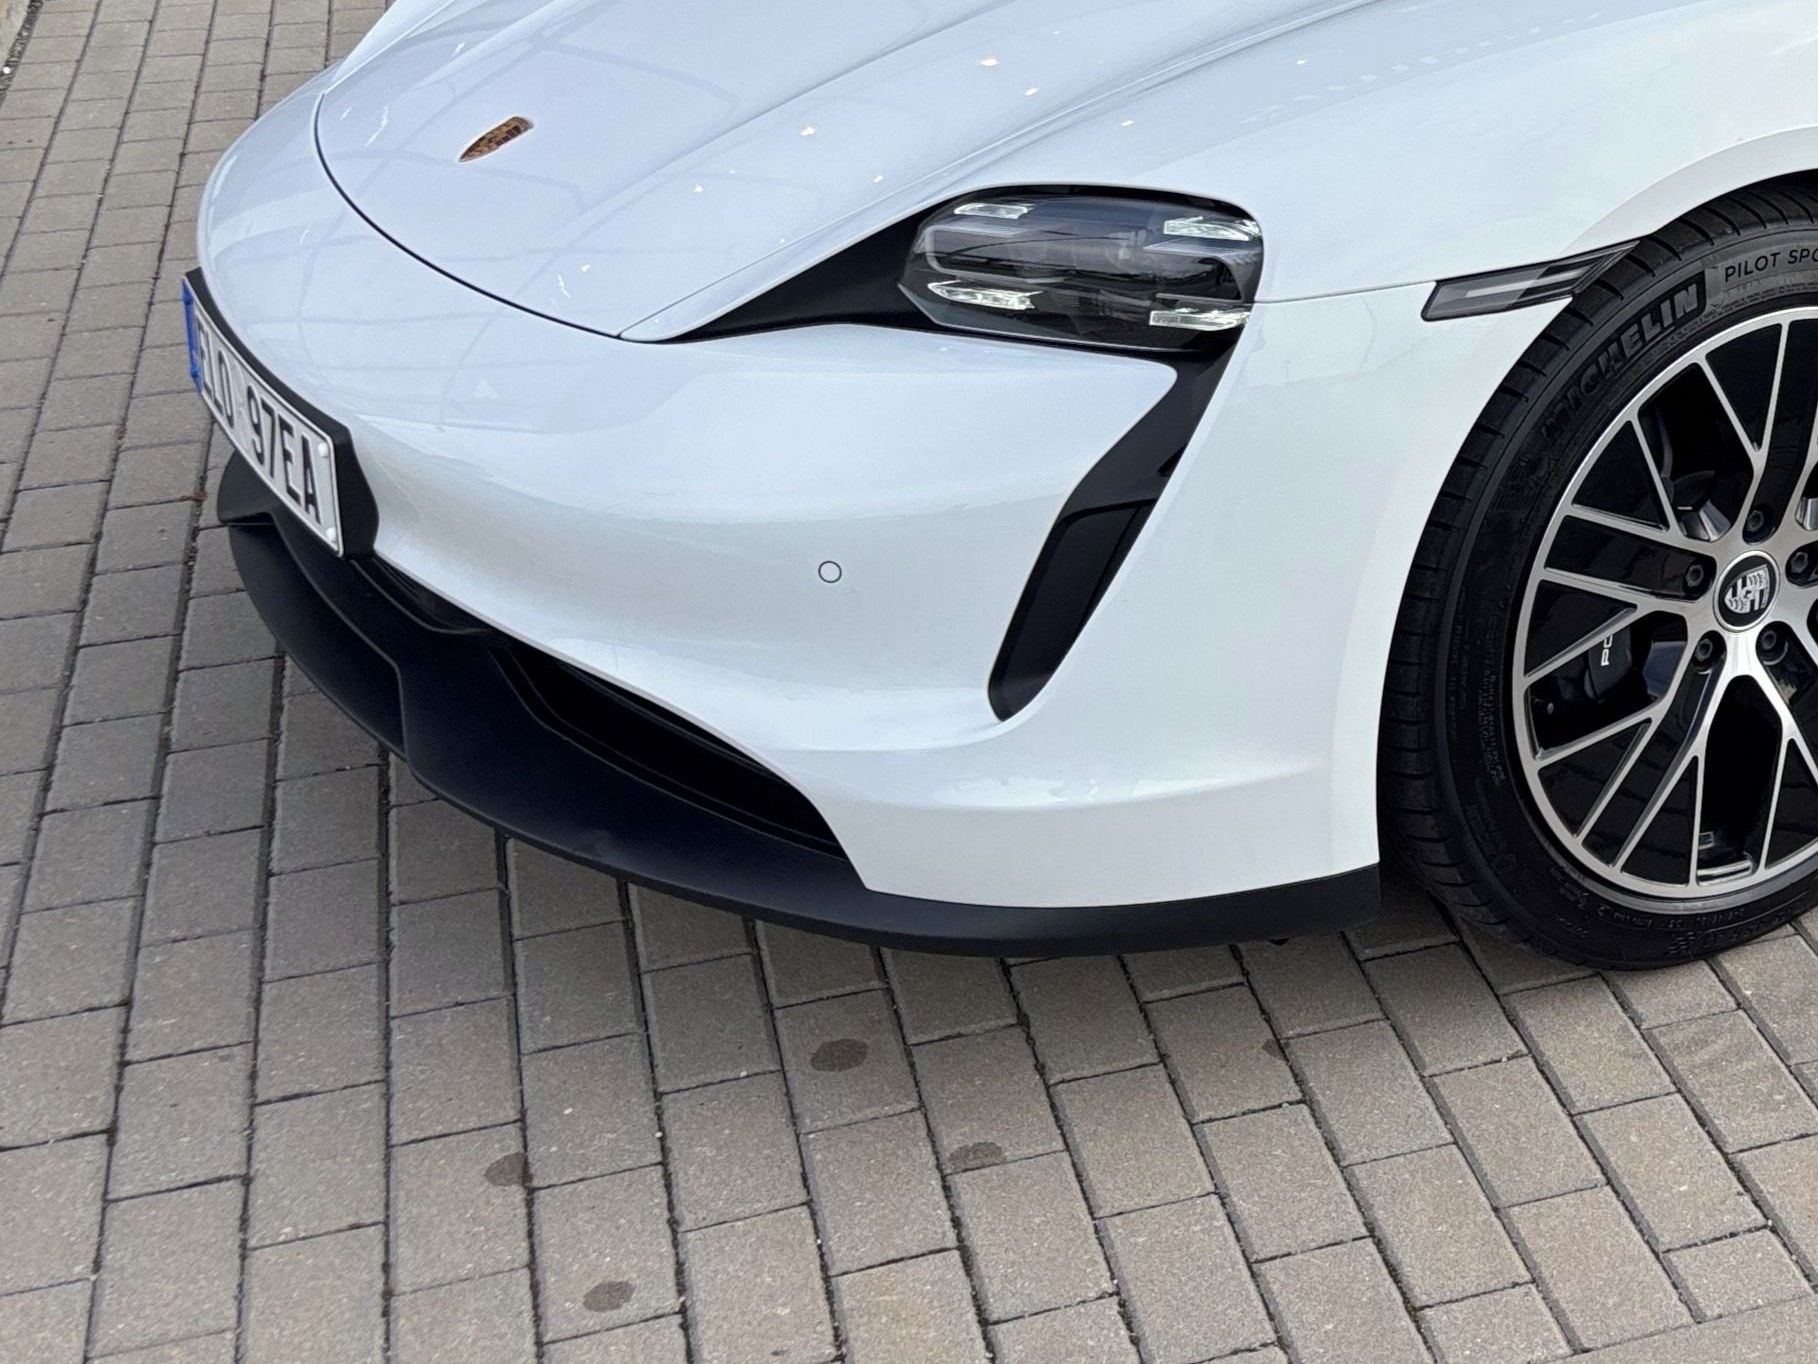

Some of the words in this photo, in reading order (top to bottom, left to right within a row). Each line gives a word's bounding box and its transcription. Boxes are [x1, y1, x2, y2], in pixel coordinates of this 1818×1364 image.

[1725, 252, 1780, 284] PILOT
[1540, 283, 1699, 440] MICHELIN
[247, 385, 322, 525] 97EA
